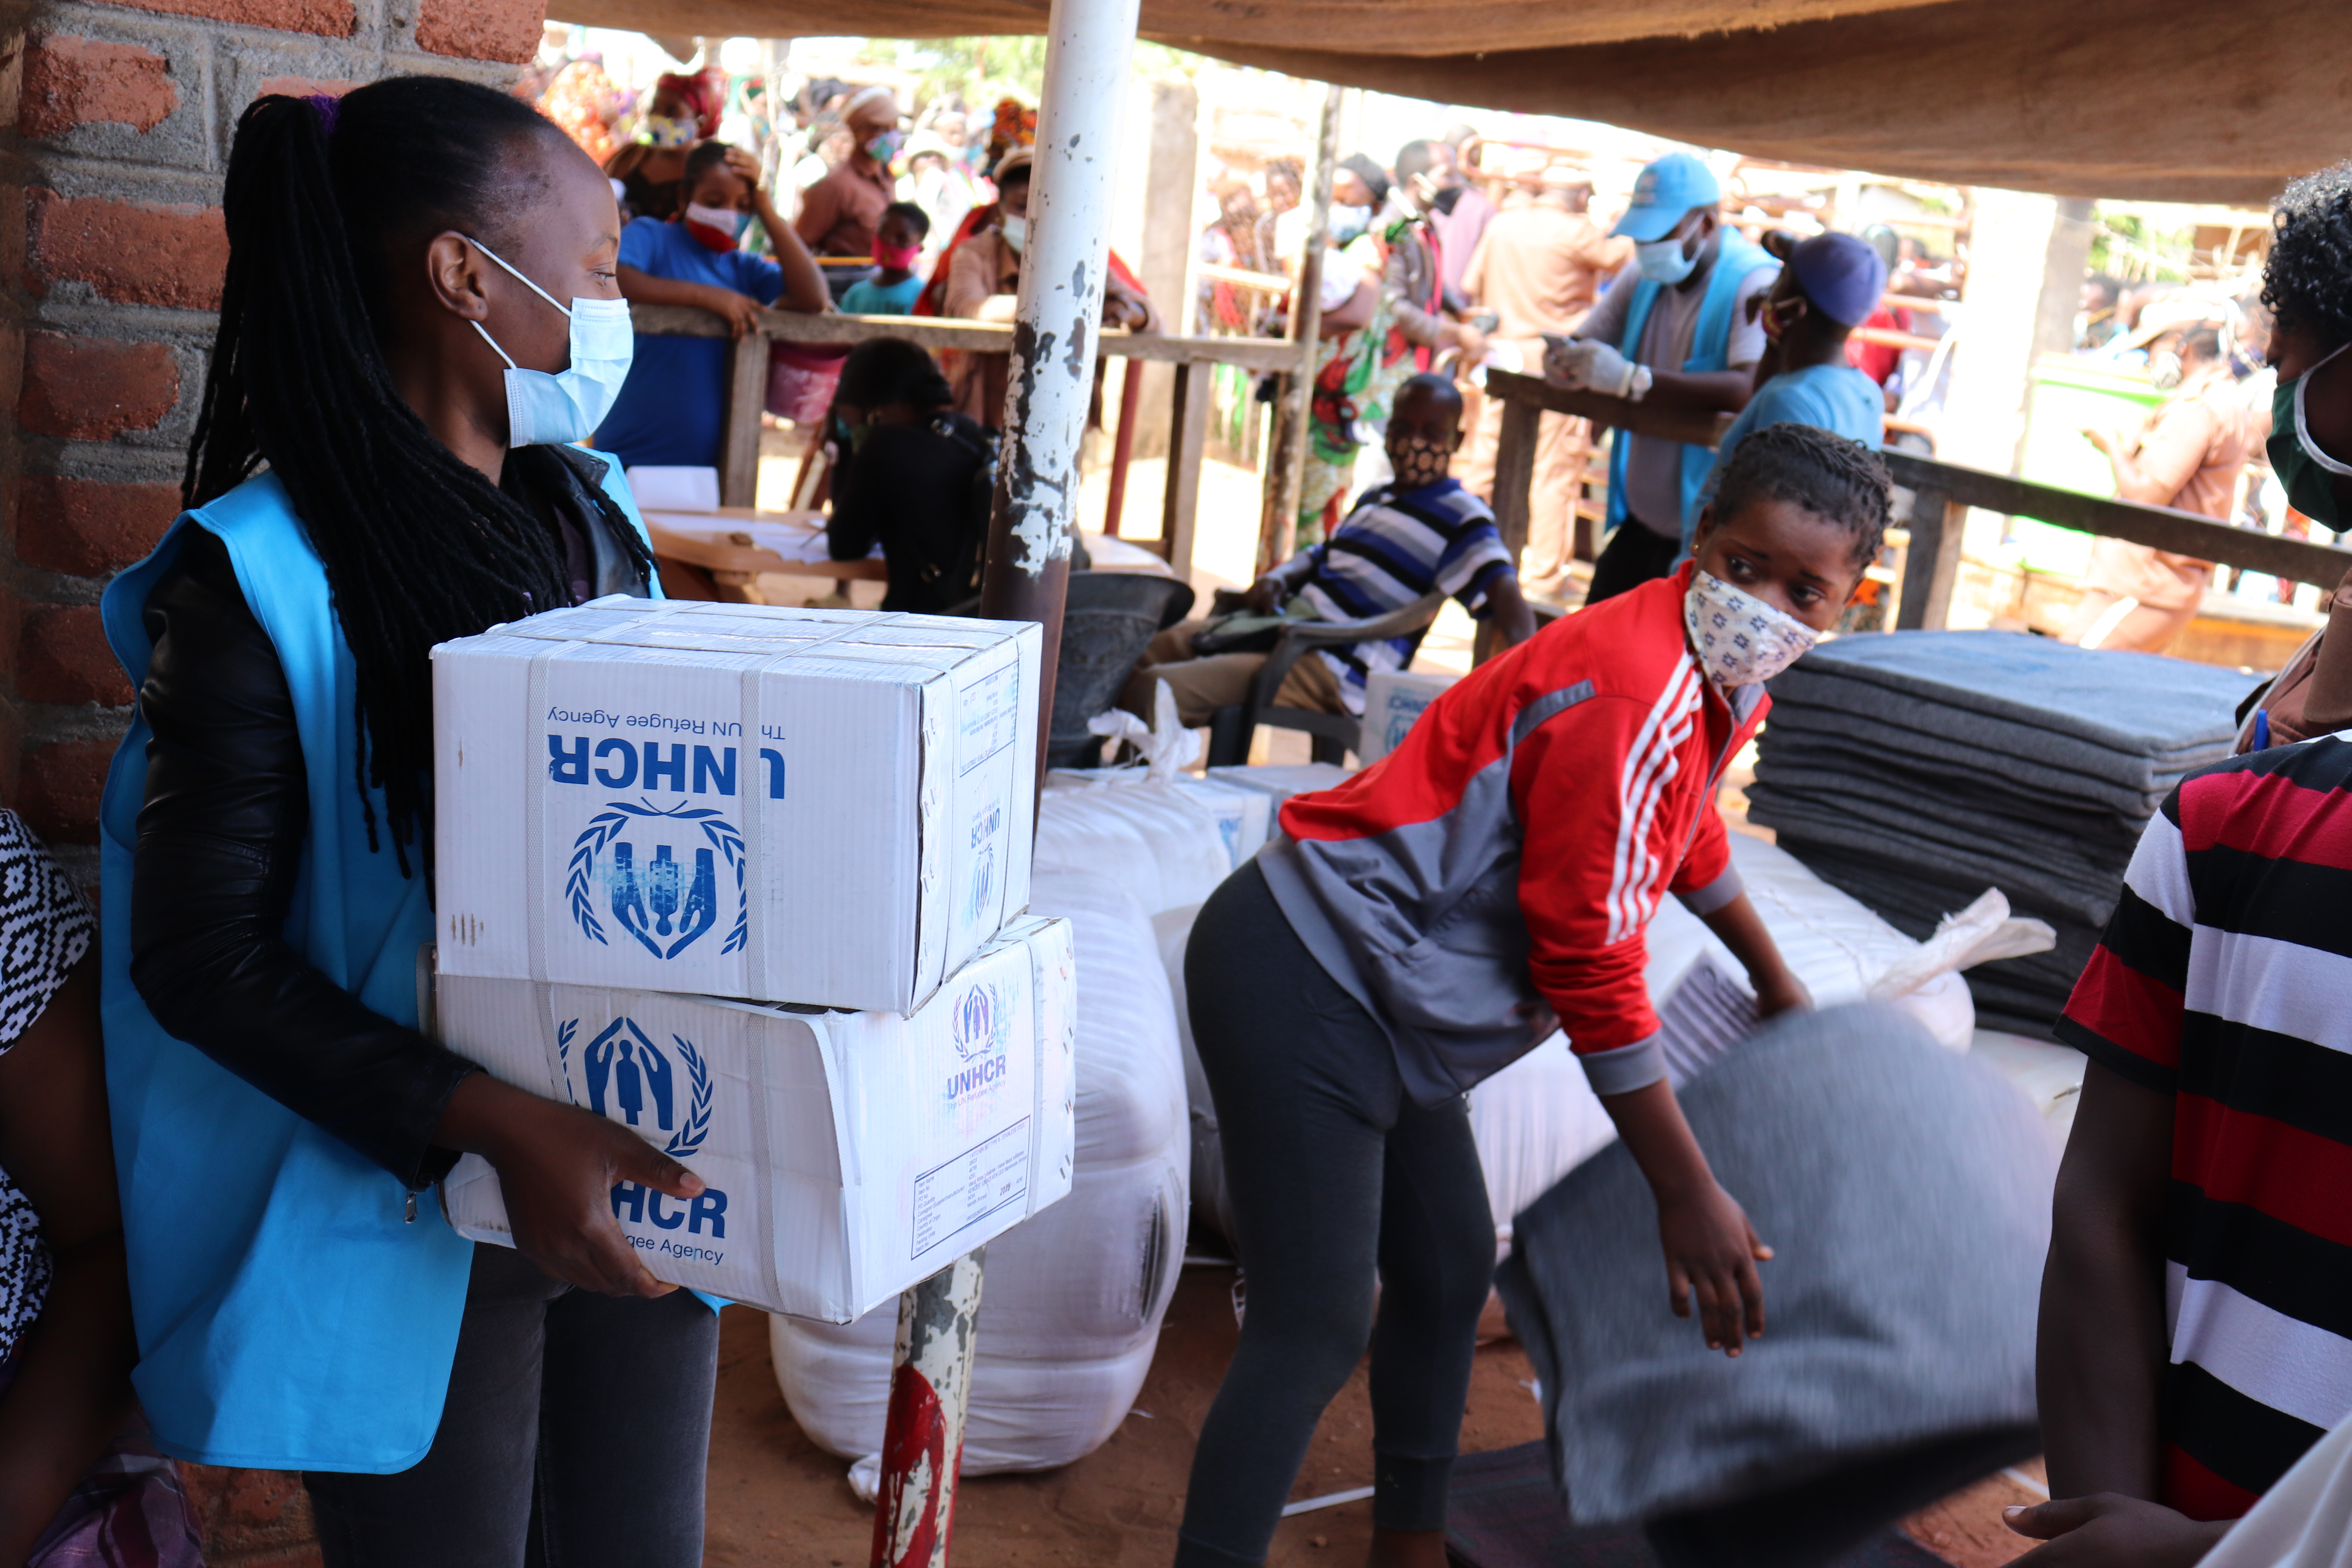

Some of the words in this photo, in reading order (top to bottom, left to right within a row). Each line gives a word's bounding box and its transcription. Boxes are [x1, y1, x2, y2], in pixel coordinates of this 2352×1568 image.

[547, 706, 620, 728] Agency
[626, 713, 704, 734] Refugee
[713, 721, 742, 737] UN
[761, 724, 786, 740] Th
[547, 734, 785, 800] UNHCR
[971, 807, 1000, 849] UNHCR
[947, 1054, 1006, 1100] UNHCR
[958, 1096, 966, 1106] UN
[967, 1088, 987, 1102] Refugee
[988, 1079, 1006, 1094] Agency
[972, 1147, 984, 1157] KITCHEN
[1002, 1127, 1016, 1140] STAINLESS
[1017, 1123, 1025, 1131] STEEL
[610, 1179, 728, 1239] HCR
[918, 1205, 933, 1217] Consignor
[924, 1197, 936, 1207] Quantity
[917, 1222, 928, 1231] Country
[933, 1214, 941, 1222] Origin
[918, 1212, 933, 1224] Consignee
[916, 1236, 928, 1246] Packing
[917, 1226, 933, 1239] Destination
[660, 1239, 724, 1266] Agency
[916, 1244, 924, 1253] Batch
